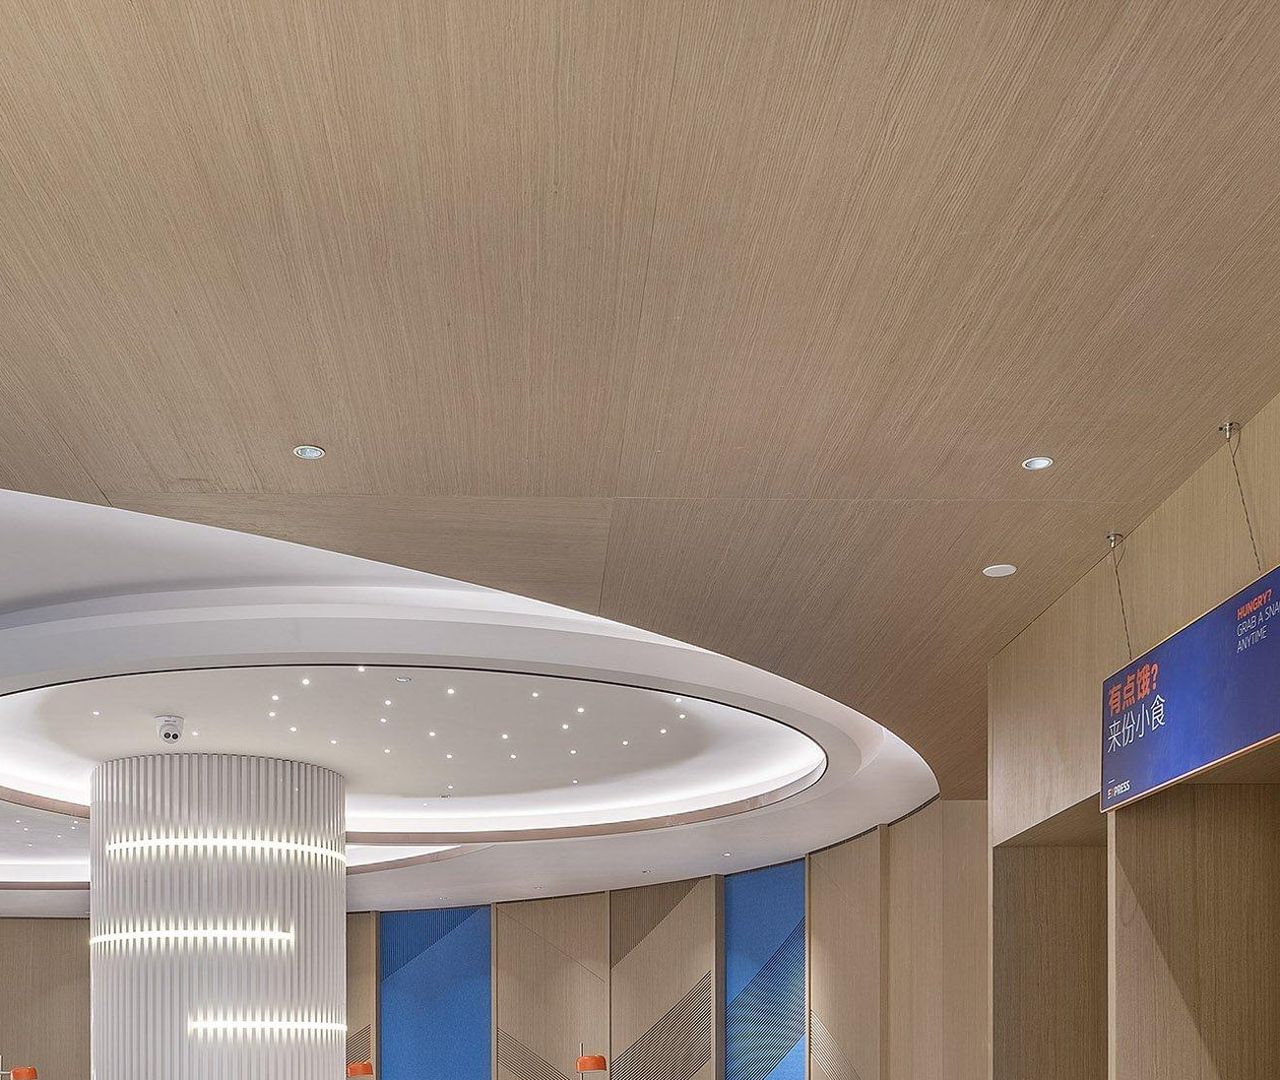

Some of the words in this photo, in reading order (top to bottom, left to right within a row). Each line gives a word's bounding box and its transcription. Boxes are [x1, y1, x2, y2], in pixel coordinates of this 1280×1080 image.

[1236, 588, 1272, 621] HUNGRY?
[1236, 615, 1257, 637] GRAB
[1257, 611, 1264, 626] A
[1236, 624, 1268, 654] ANYTIME
[1107, 694, 1166, 753] 来份小食
